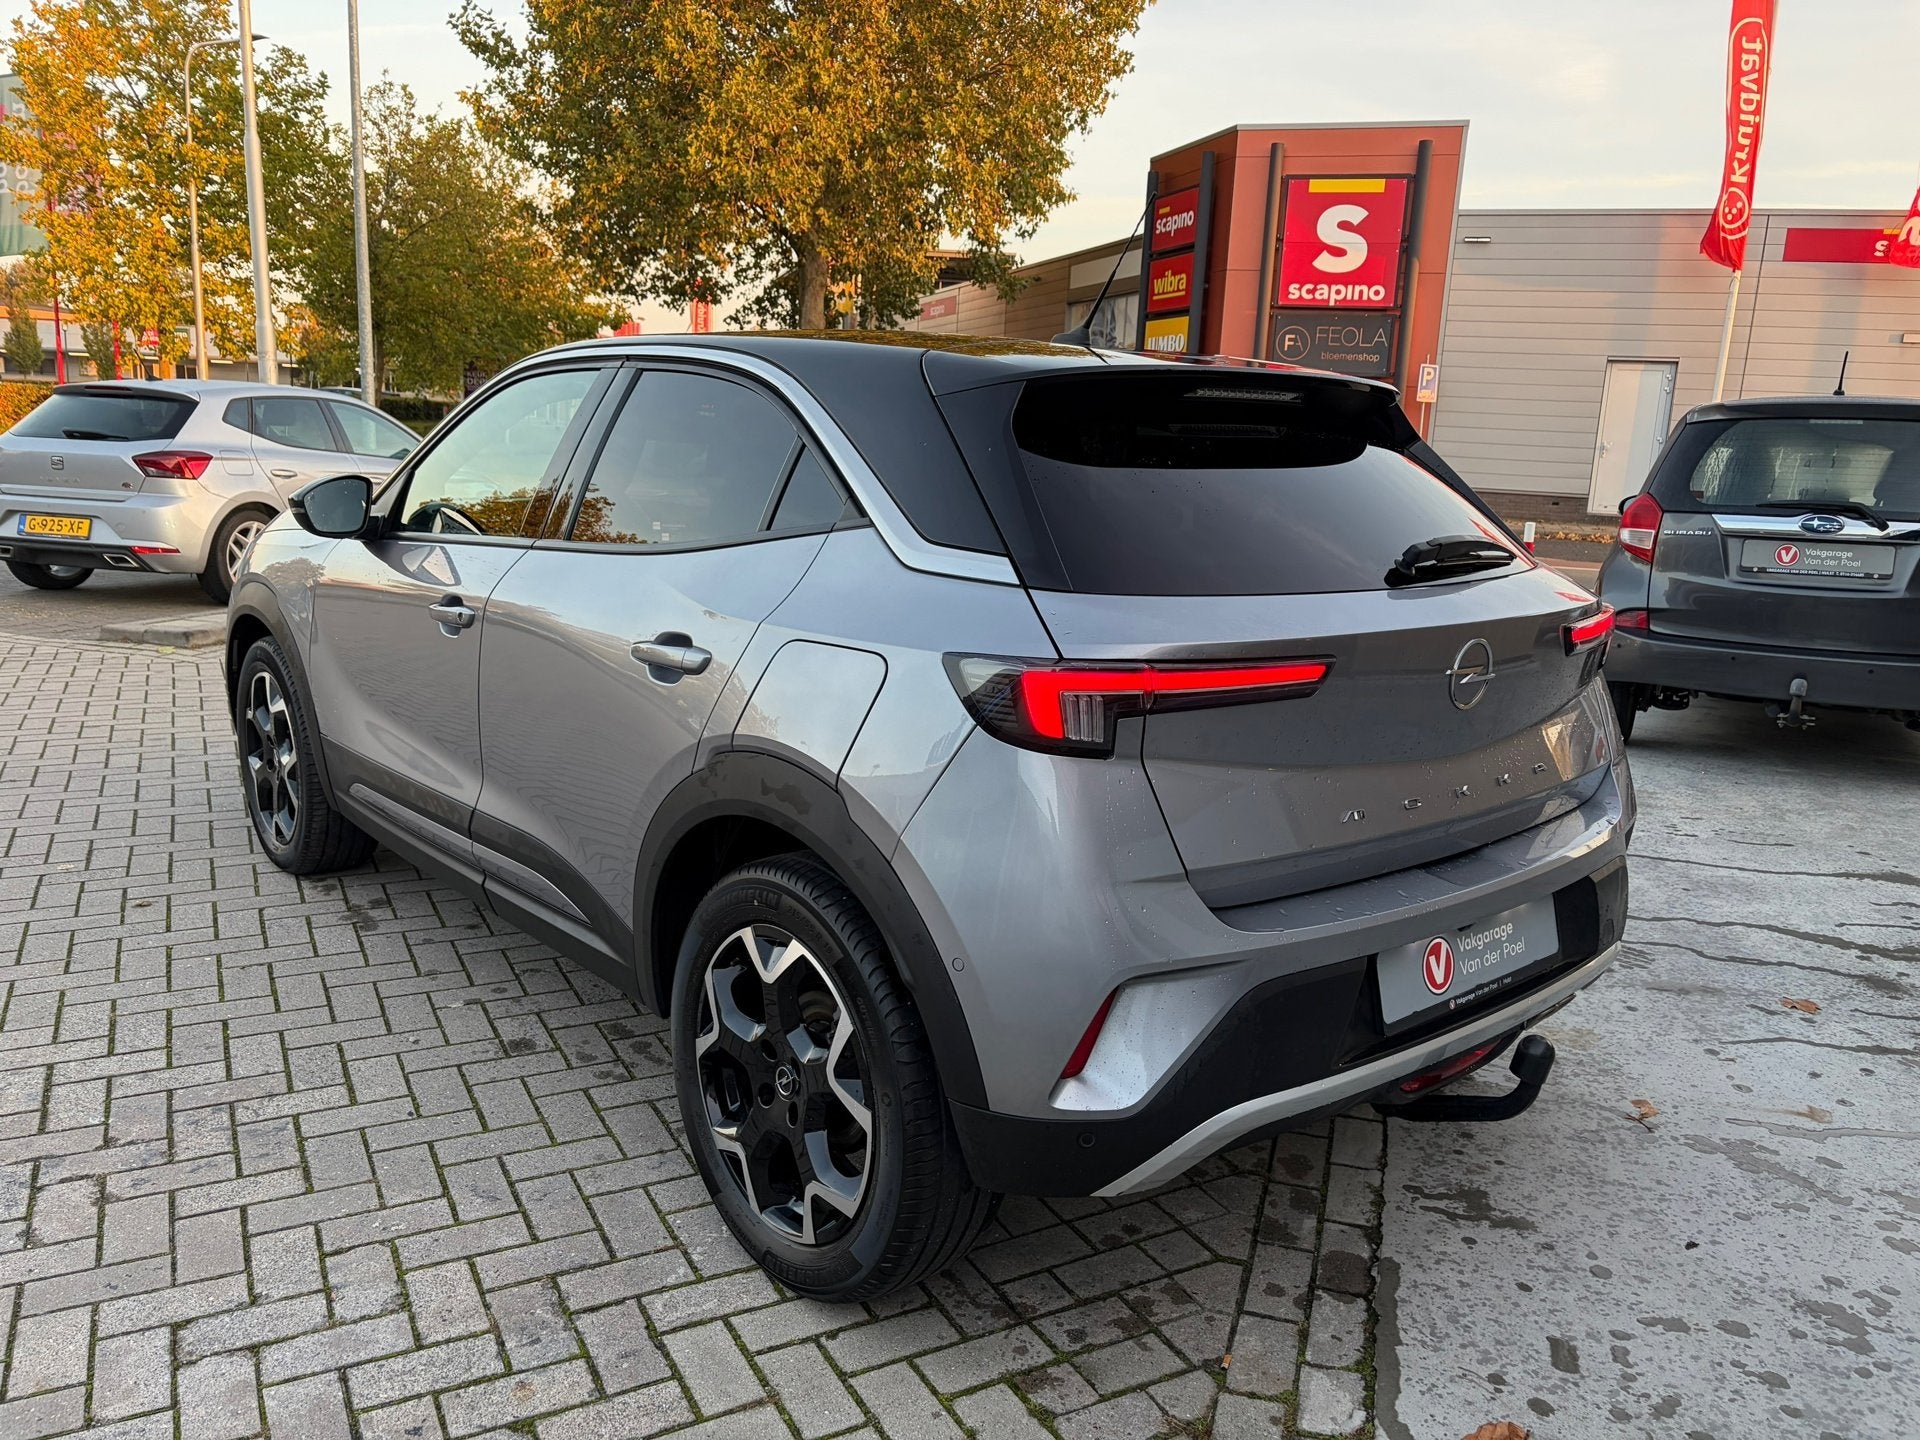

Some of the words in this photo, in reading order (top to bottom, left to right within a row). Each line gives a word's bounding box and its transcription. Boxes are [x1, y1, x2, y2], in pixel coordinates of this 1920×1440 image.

[1155, 209, 1194, 237] scapino
[1153, 270, 1186, 294] wibra
[1287, 282, 1386, 306] scapino
[1315, 326, 1388, 347] FEOLA
[1321, 351, 1380, 363] bloemenshop
[1422, 367, 1435, 387] P
[1803, 556, 1821, 565] Van
[1823, 558, 1839, 566] der
[1841, 559, 1861, 568] Poel
[1805, 548, 1853, 559] Vakgarage
[1457, 921, 1514, 952] Vakgarage
[1459, 956, 1483, 976] Van
[1483, 949, 1501, 969] der
[1503, 937, 1525, 959] Poel
